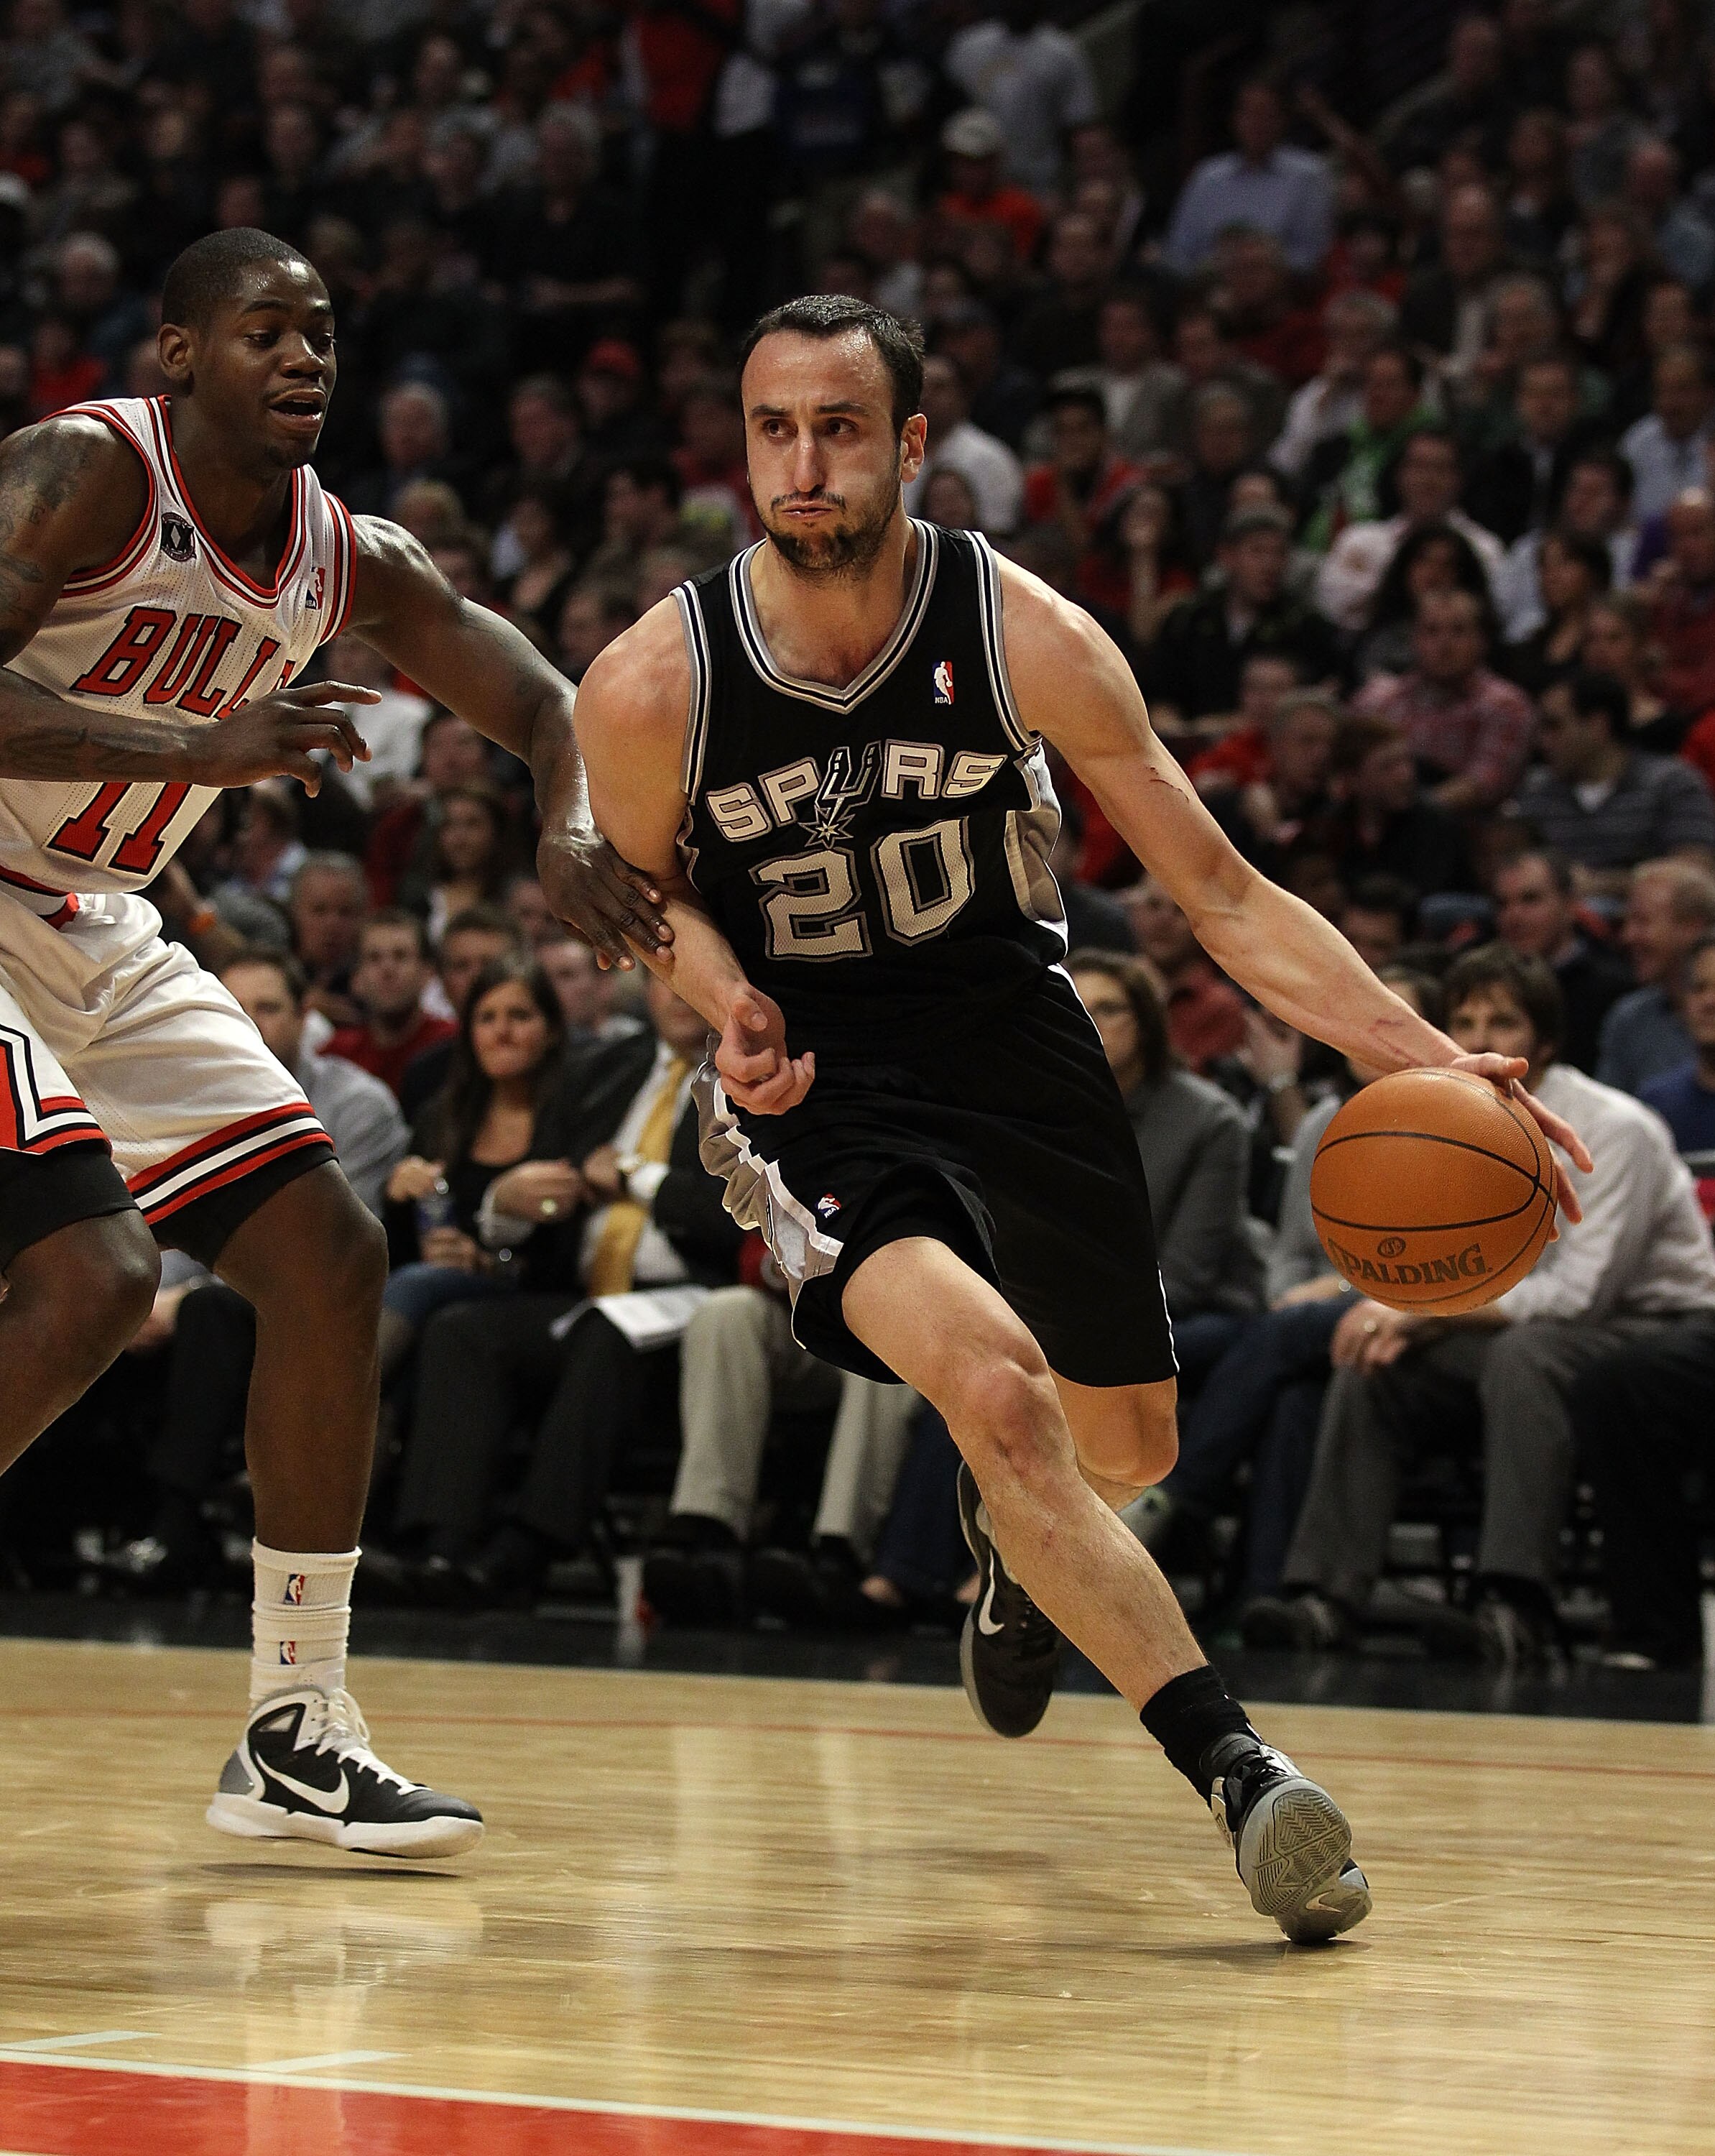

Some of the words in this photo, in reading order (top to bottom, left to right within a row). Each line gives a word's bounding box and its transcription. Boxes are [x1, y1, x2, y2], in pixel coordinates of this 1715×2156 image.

[706, 739, 1007, 843] SPURS
[748, 816, 975, 962] 20
[824, 1207, 836, 1218] NBA
